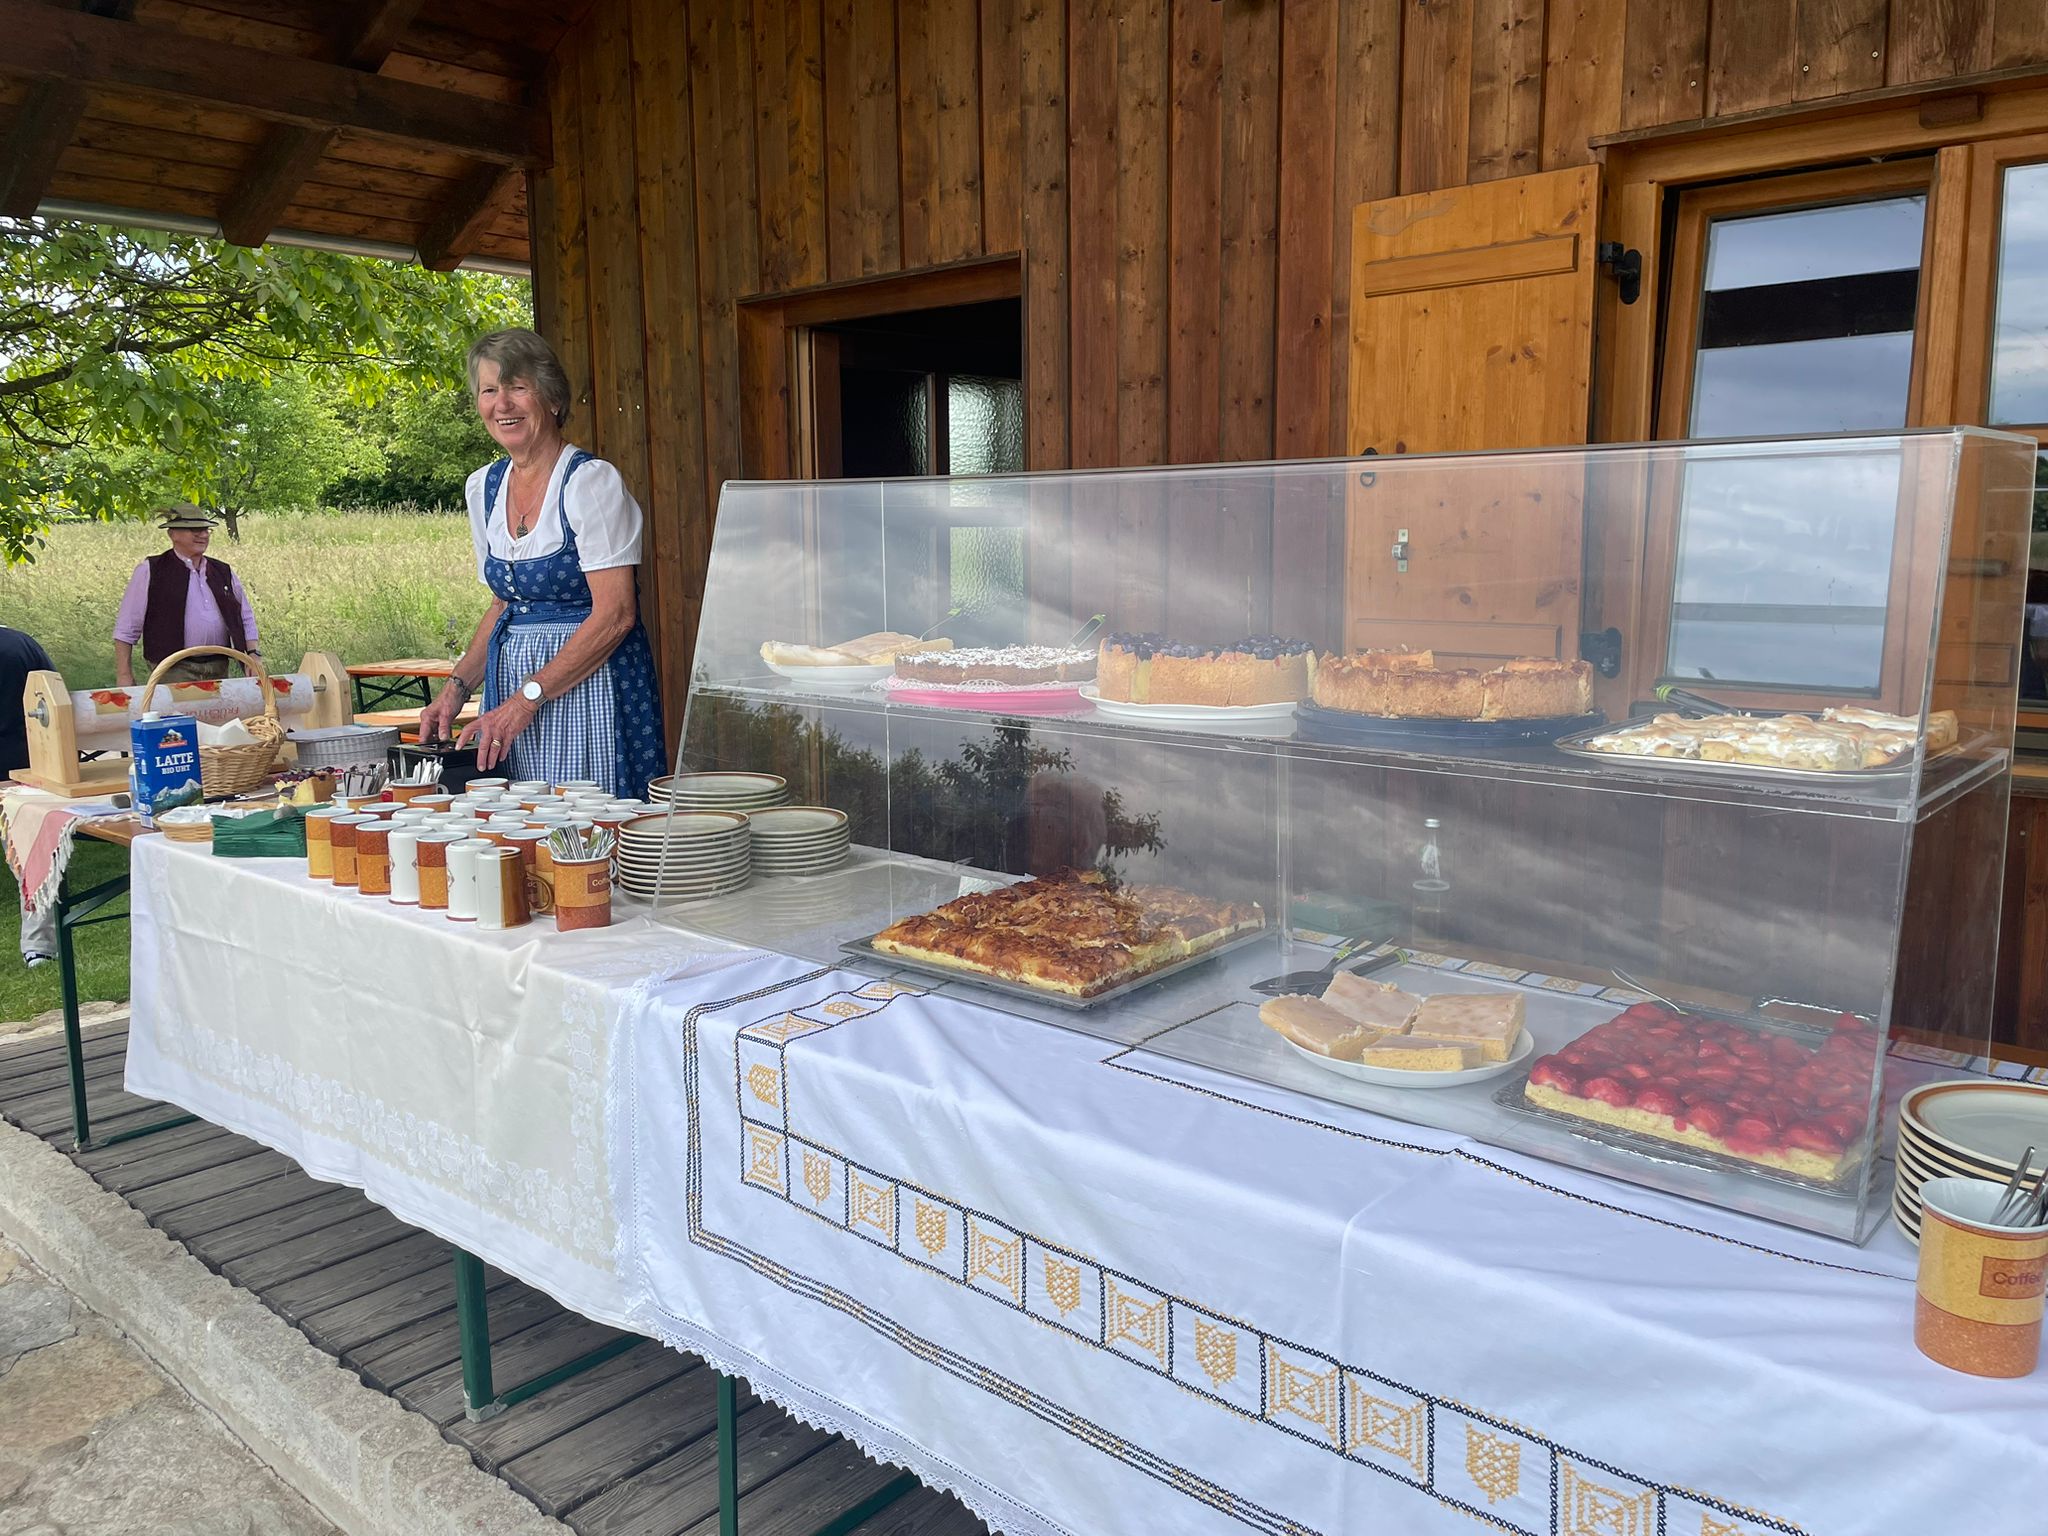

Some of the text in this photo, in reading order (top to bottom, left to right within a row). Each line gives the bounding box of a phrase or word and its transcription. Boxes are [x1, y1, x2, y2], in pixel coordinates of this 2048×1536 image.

[155, 752, 194, 768] LATTE
[161, 764, 191, 775] BIO UHT
